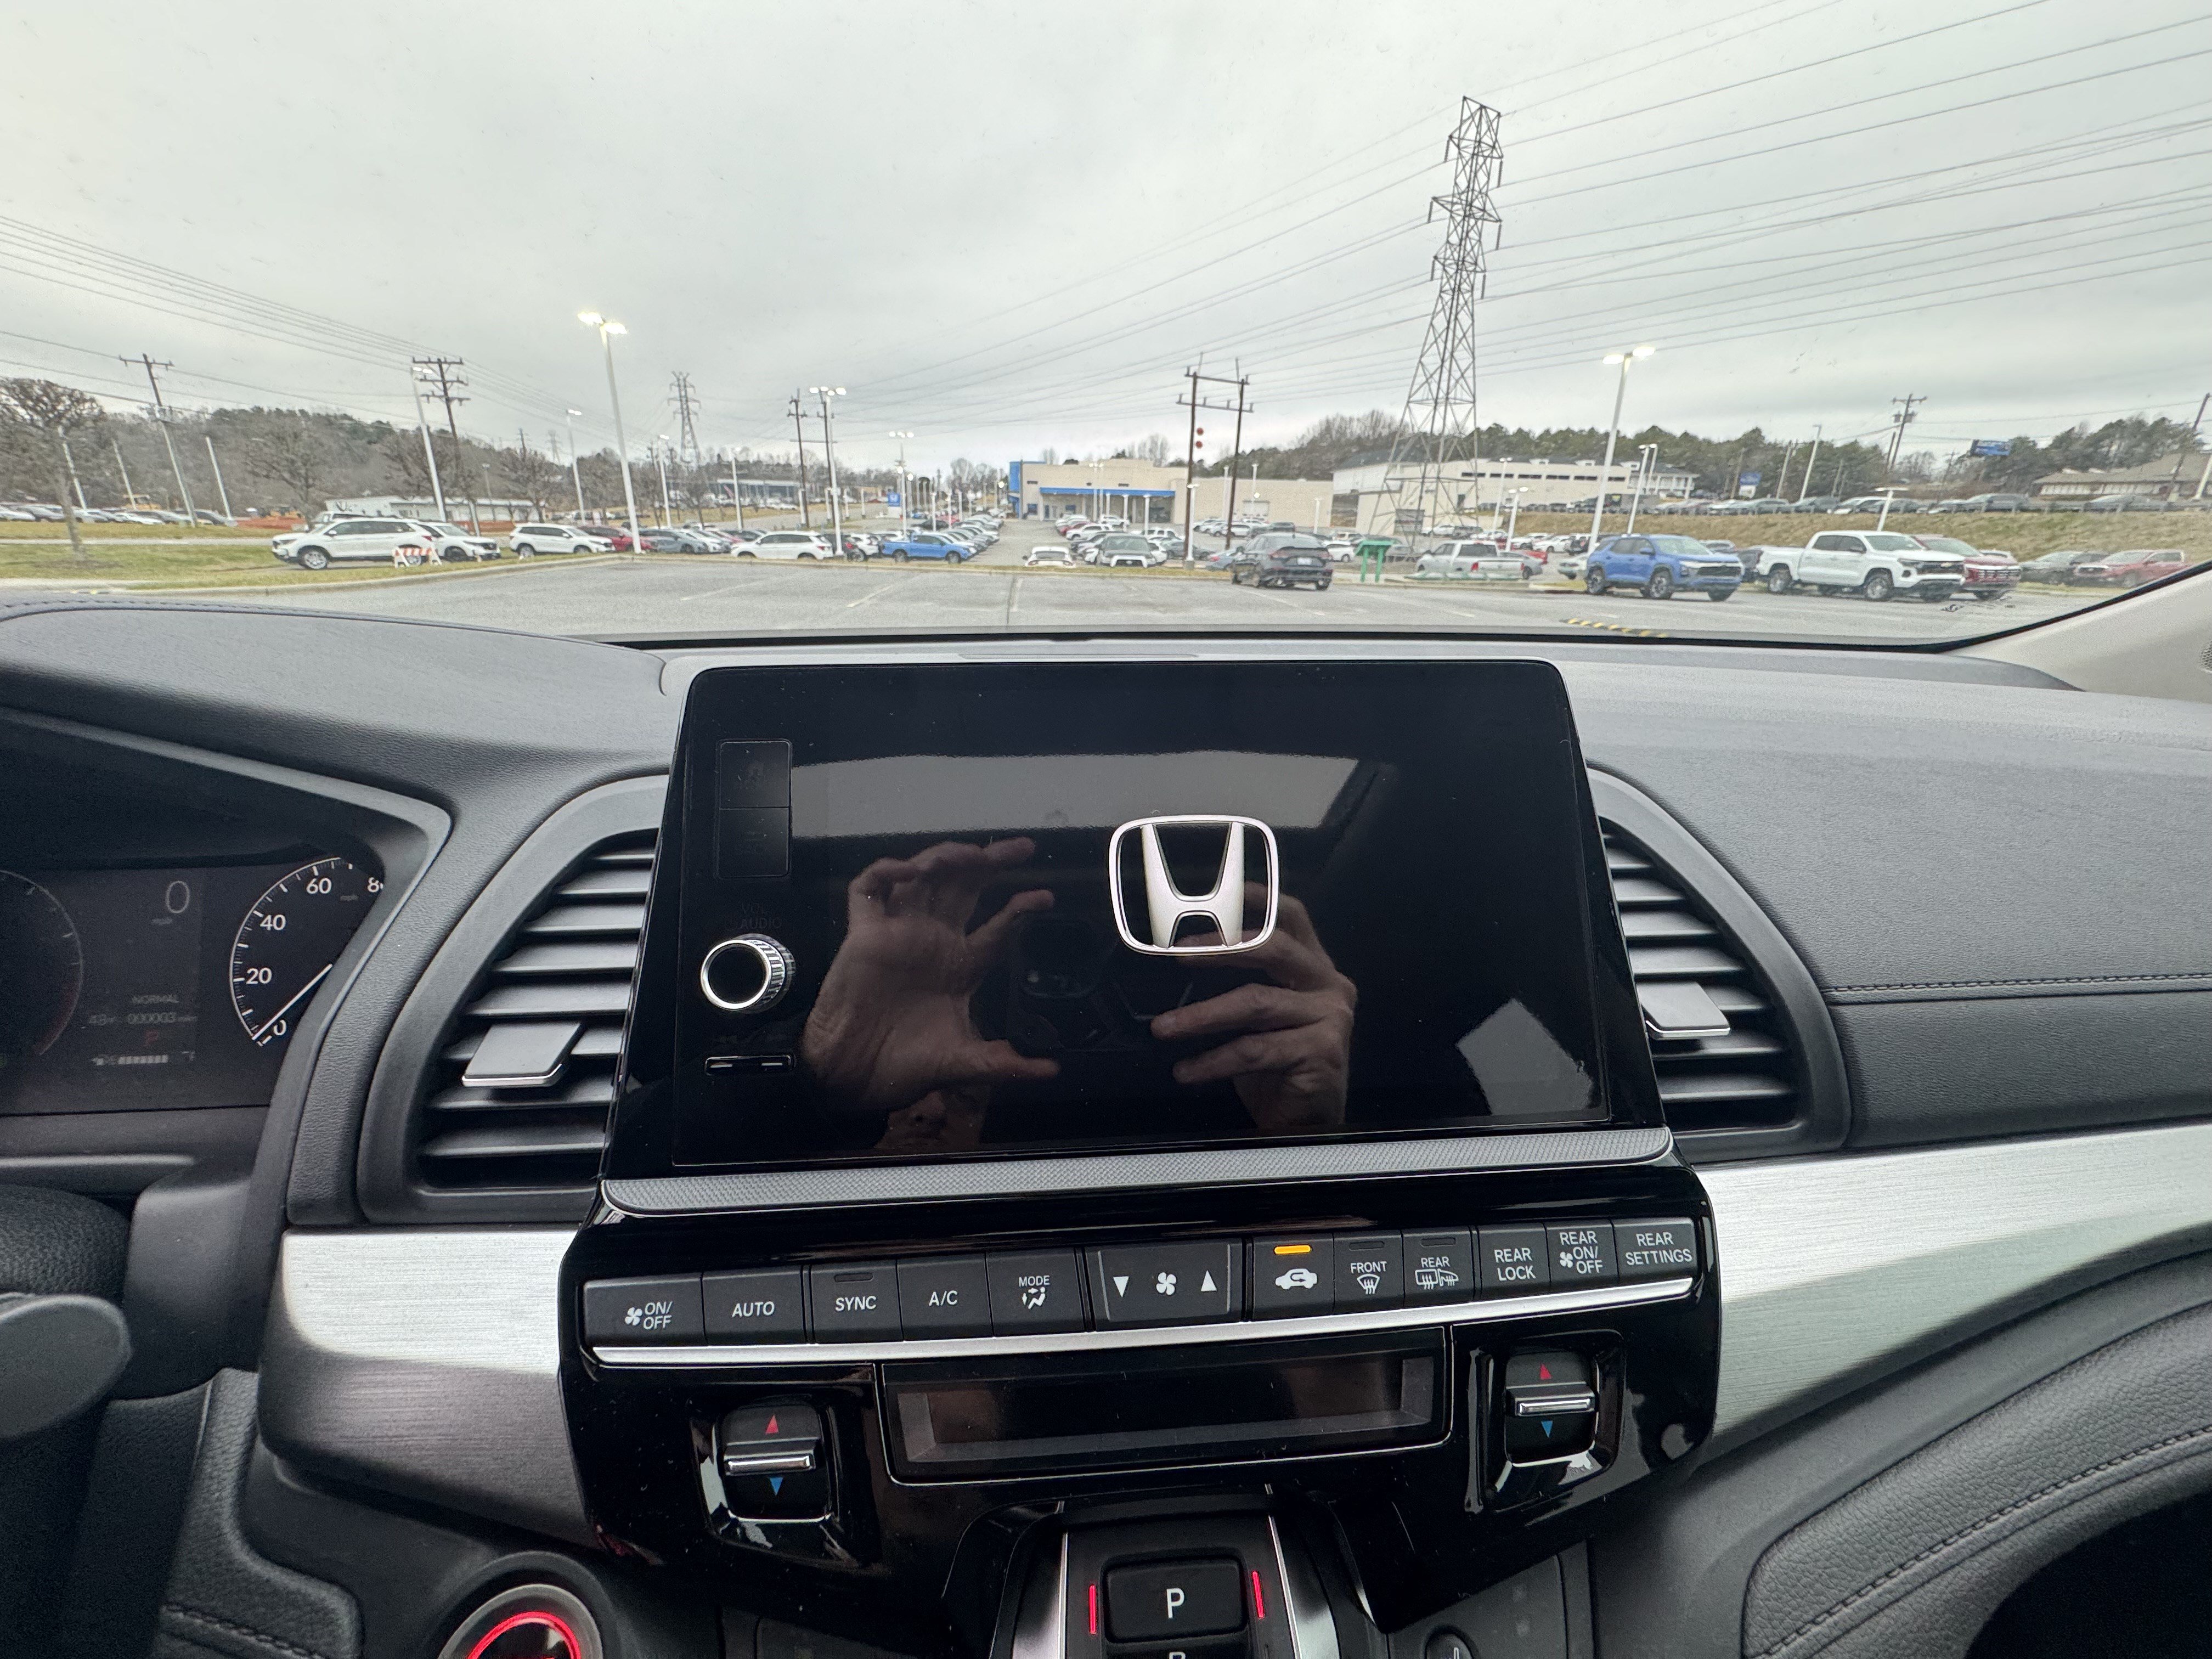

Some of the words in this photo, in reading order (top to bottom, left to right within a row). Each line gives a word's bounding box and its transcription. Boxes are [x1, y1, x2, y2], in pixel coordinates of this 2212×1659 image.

[306, 877, 332, 894] 60
[166, 881, 190, 913] 0
[259, 915, 286, 931] 40
[738, 917, 782, 929] AUDIO
[246, 968, 272, 984] 20
[273, 1020, 286, 1036] 0
[1560, 1231, 1598, 1245] REAR
[1636, 1232, 1674, 1246] REAR
[1494, 1248, 1532, 1263] REAR
[1572, 1246, 1598, 1260] ON/
[1625, 1249, 1692, 1266] SETTINGS
[1350, 1261, 1387, 1273] FRONT
[1421, 1256, 1450, 1268] REAR
[1576, 1260, 1603, 1274] OFF
[1019, 1275, 1050, 1286] MODE
[1497, 1265, 1536, 1282] LOCK
[835, 1295, 877, 1312] SYNC
[928, 1290, 958, 1307] A/C
[644, 1301, 673, 1315] ON/
[731, 1301, 775, 1318] AUTO
[643, 1315, 672, 1330] OFF
[1166, 1588, 1185, 1618] P
